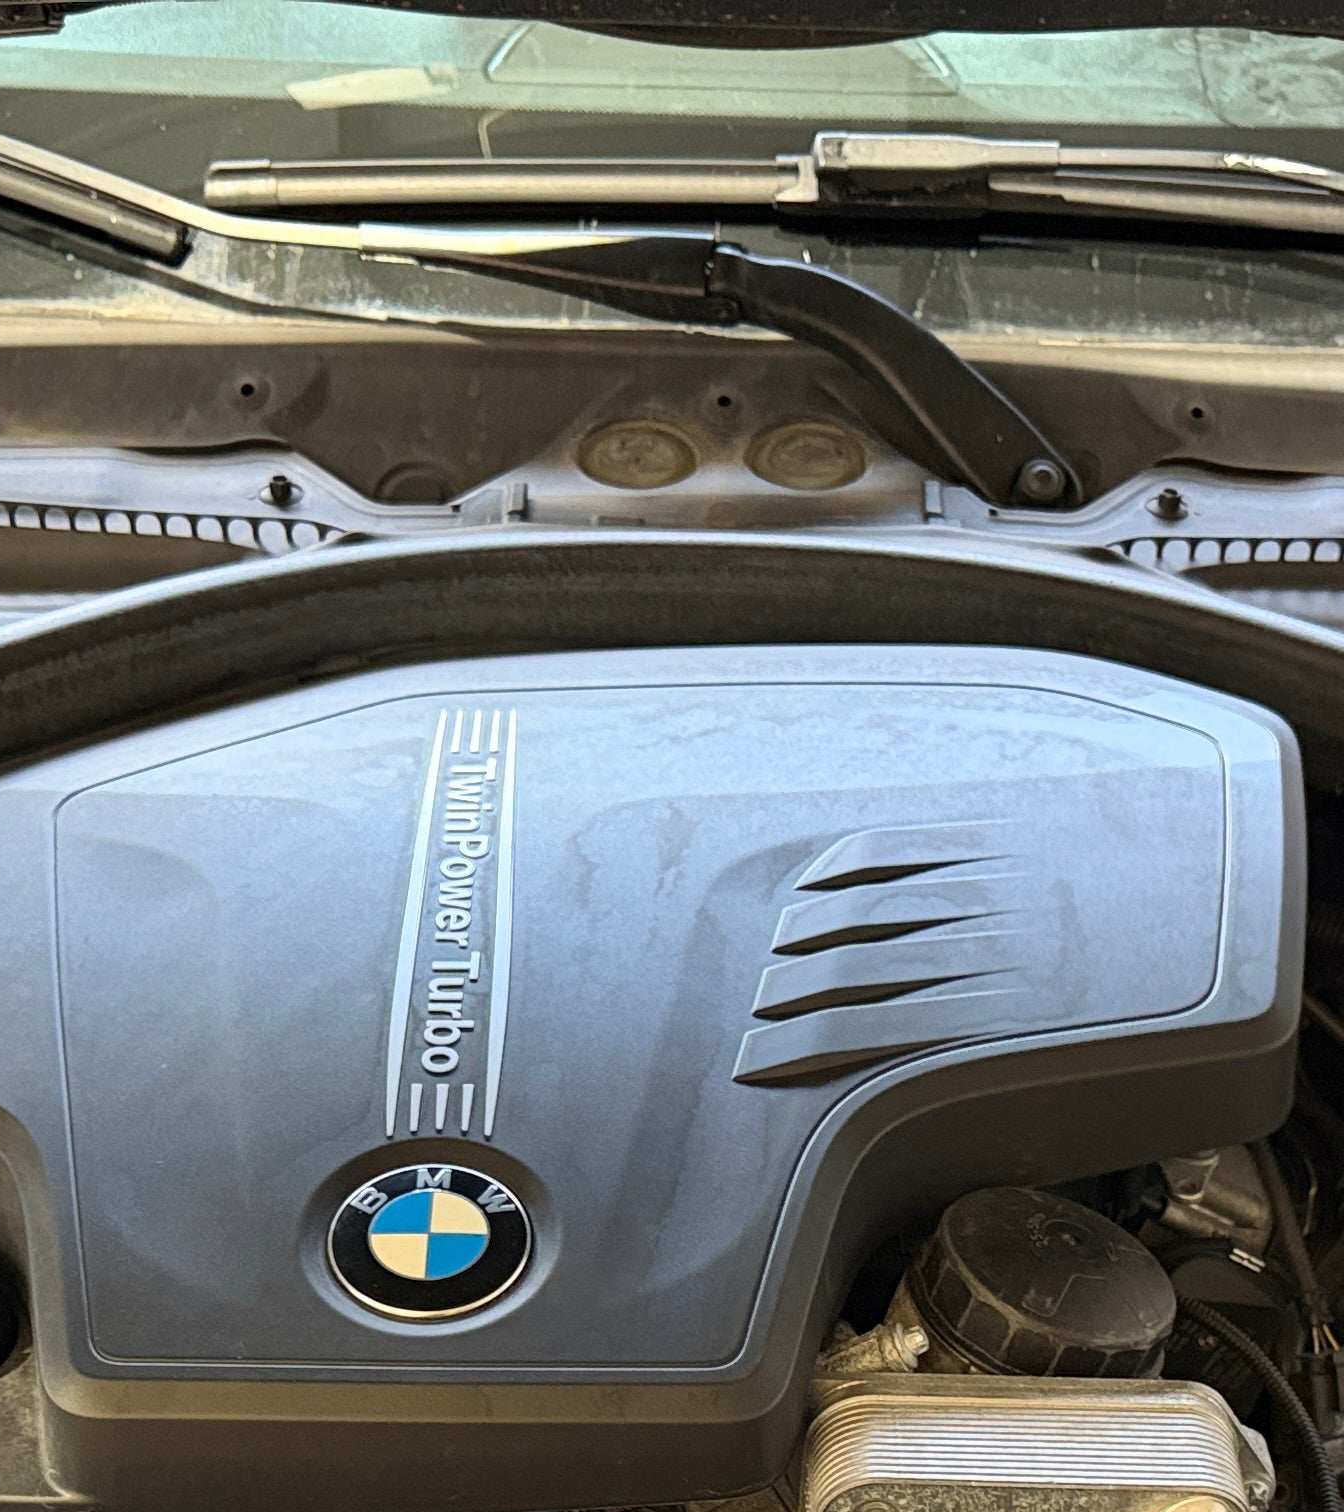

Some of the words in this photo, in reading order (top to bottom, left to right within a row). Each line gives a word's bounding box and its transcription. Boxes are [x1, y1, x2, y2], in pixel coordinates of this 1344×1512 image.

[434, 757, 498, 949] TwinPower
[421, 951, 482, 1075] Turbo
[349, 1167, 516, 1216] BMW
